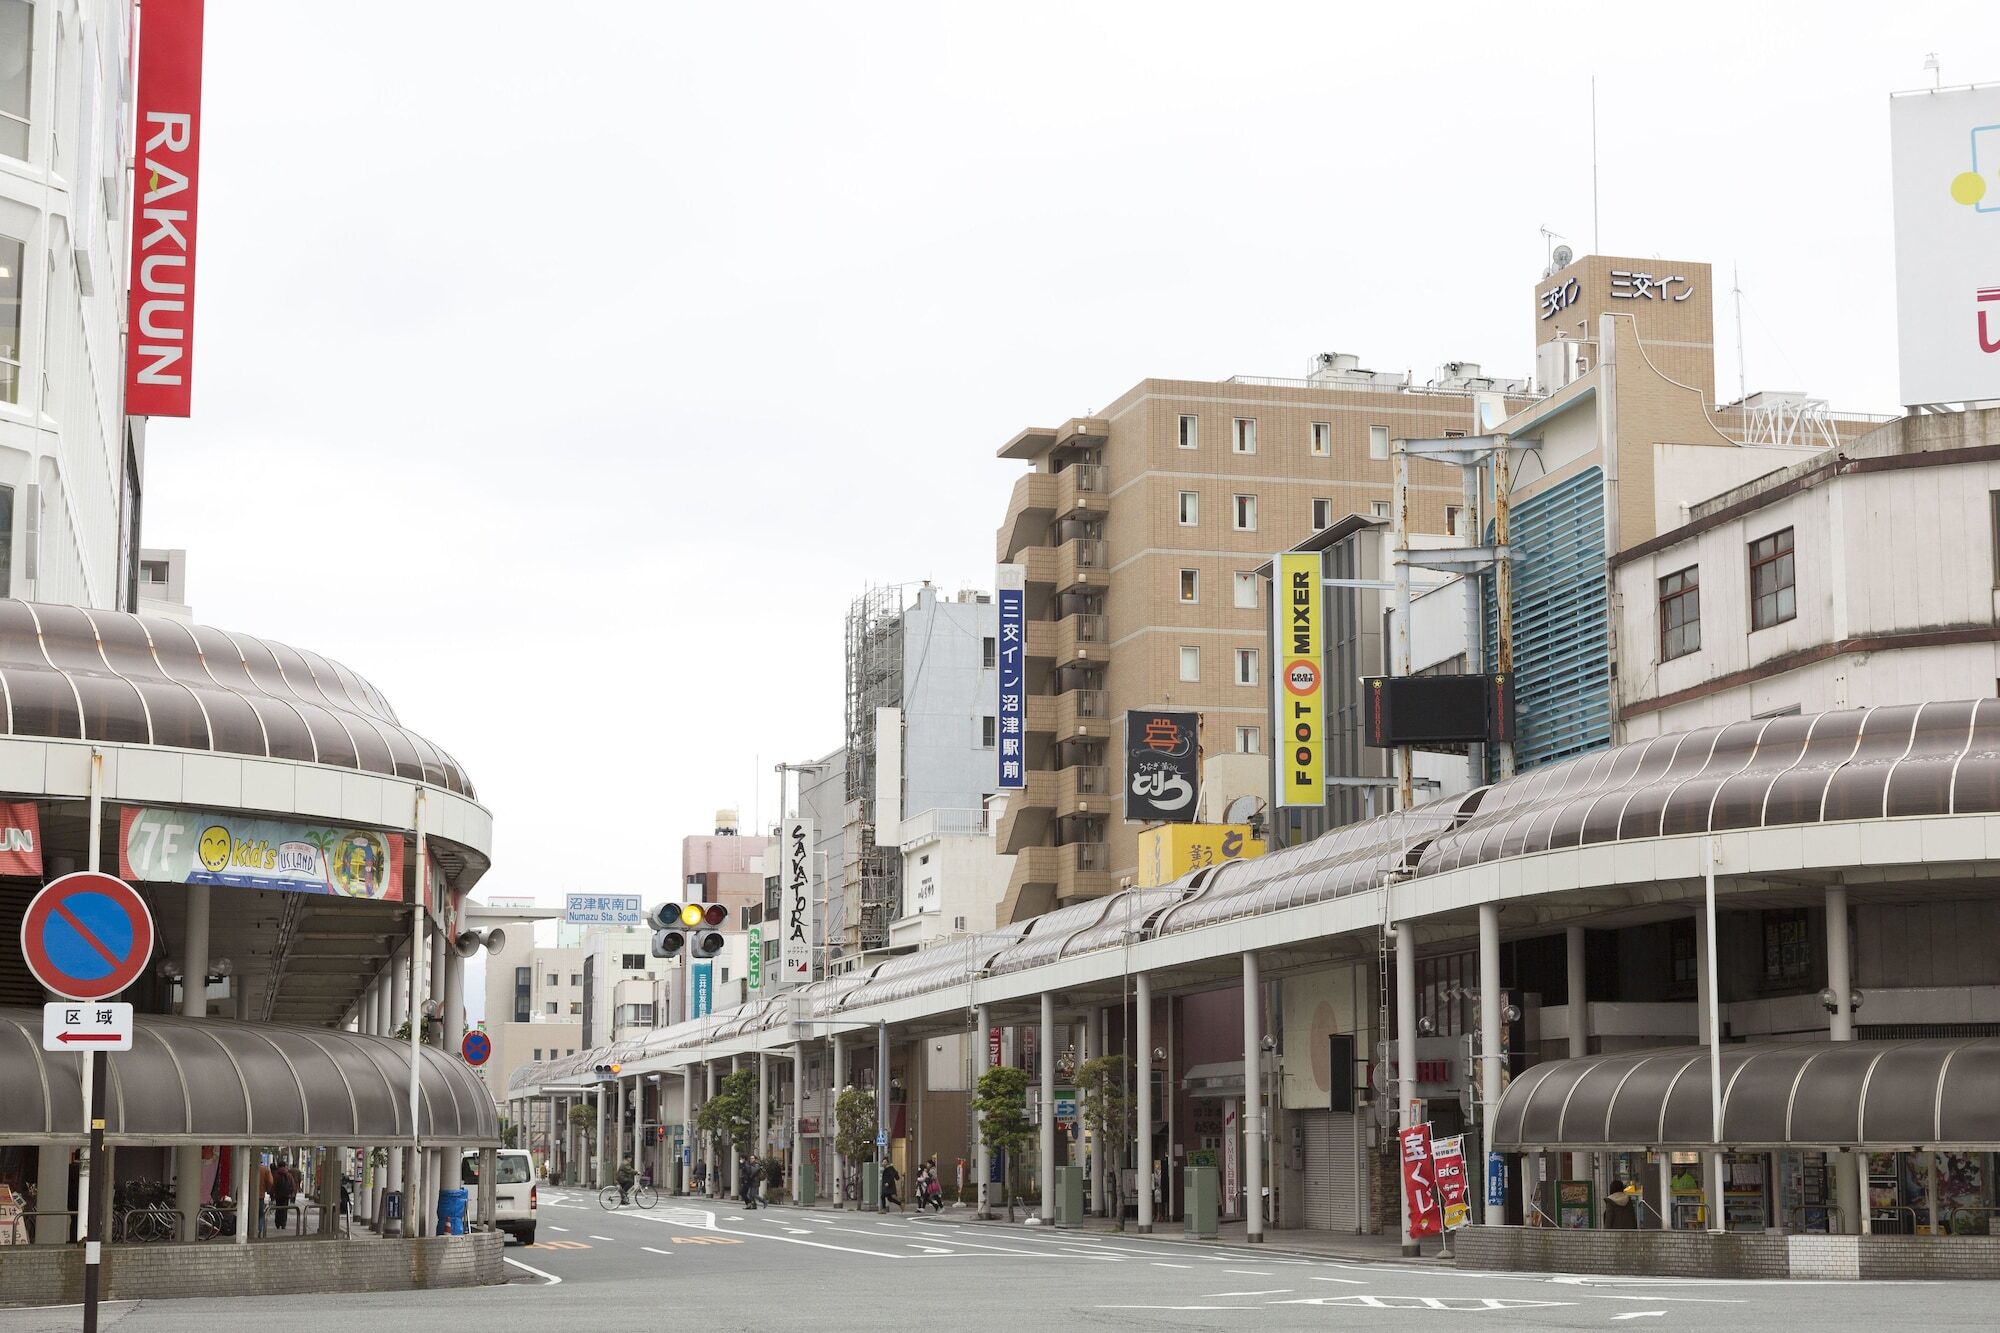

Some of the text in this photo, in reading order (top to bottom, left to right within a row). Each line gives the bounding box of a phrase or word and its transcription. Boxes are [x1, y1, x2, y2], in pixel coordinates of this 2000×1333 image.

[136, 111, 191, 386] RAKUUN
[1541, 277, 1581, 320] 三交イン
[1611, 270, 1694, 301] 三交イン
[1294, 571, 1311, 654] MIXER
[1002, 598, 1020, 779] 三交イン沼津駅前
[1295, 701, 1313, 785] FOOT
[138, 822, 185, 872] 7F
[232, 836, 278, 871] Kid's
[569, 897, 638, 911] 沼津駅南口
[790, 825, 808, 943] SAVATORA
[569, 911, 599, 921] Numazu
[617, 912, 638, 922] South
[749, 932, 760, 987] 丸天ビル
[788, 959, 799, 967] B1
[66, 1009, 112, 1024] 区域
[1405, 1133, 1434, 1214] 宝くじ
[1438, 1163, 1460, 1178] BIG
